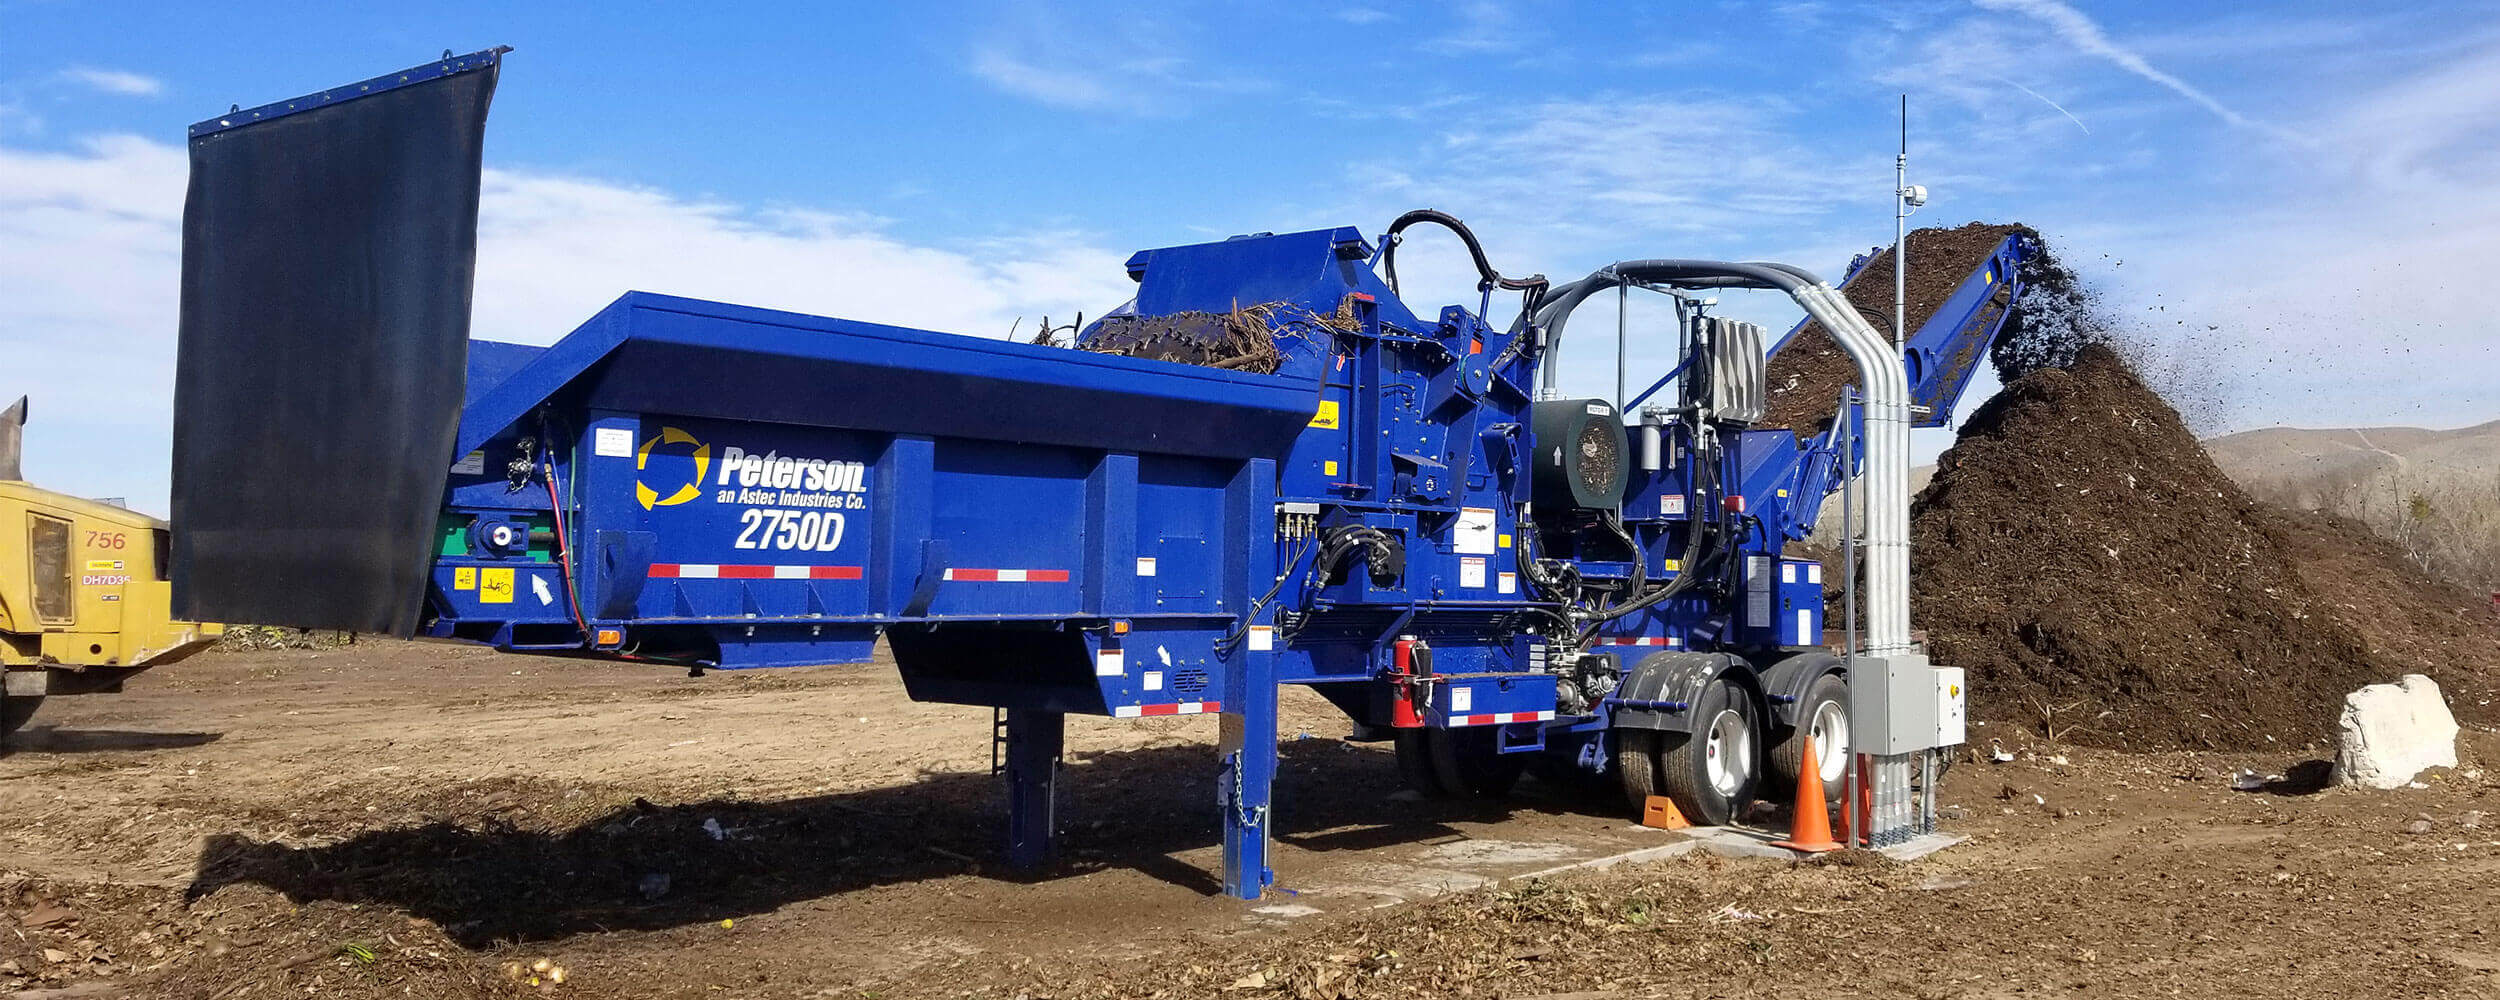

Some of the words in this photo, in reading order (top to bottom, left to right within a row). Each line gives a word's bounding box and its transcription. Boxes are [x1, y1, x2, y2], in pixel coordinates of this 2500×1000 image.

[717, 490, 735, 503] an
[737, 488, 776, 505] Astec
[778, 490, 843, 509] Industries
[845, 493, 866, 509] Co.
[86, 530, 126, 549] 756
[734, 508, 845, 552] 2750D
